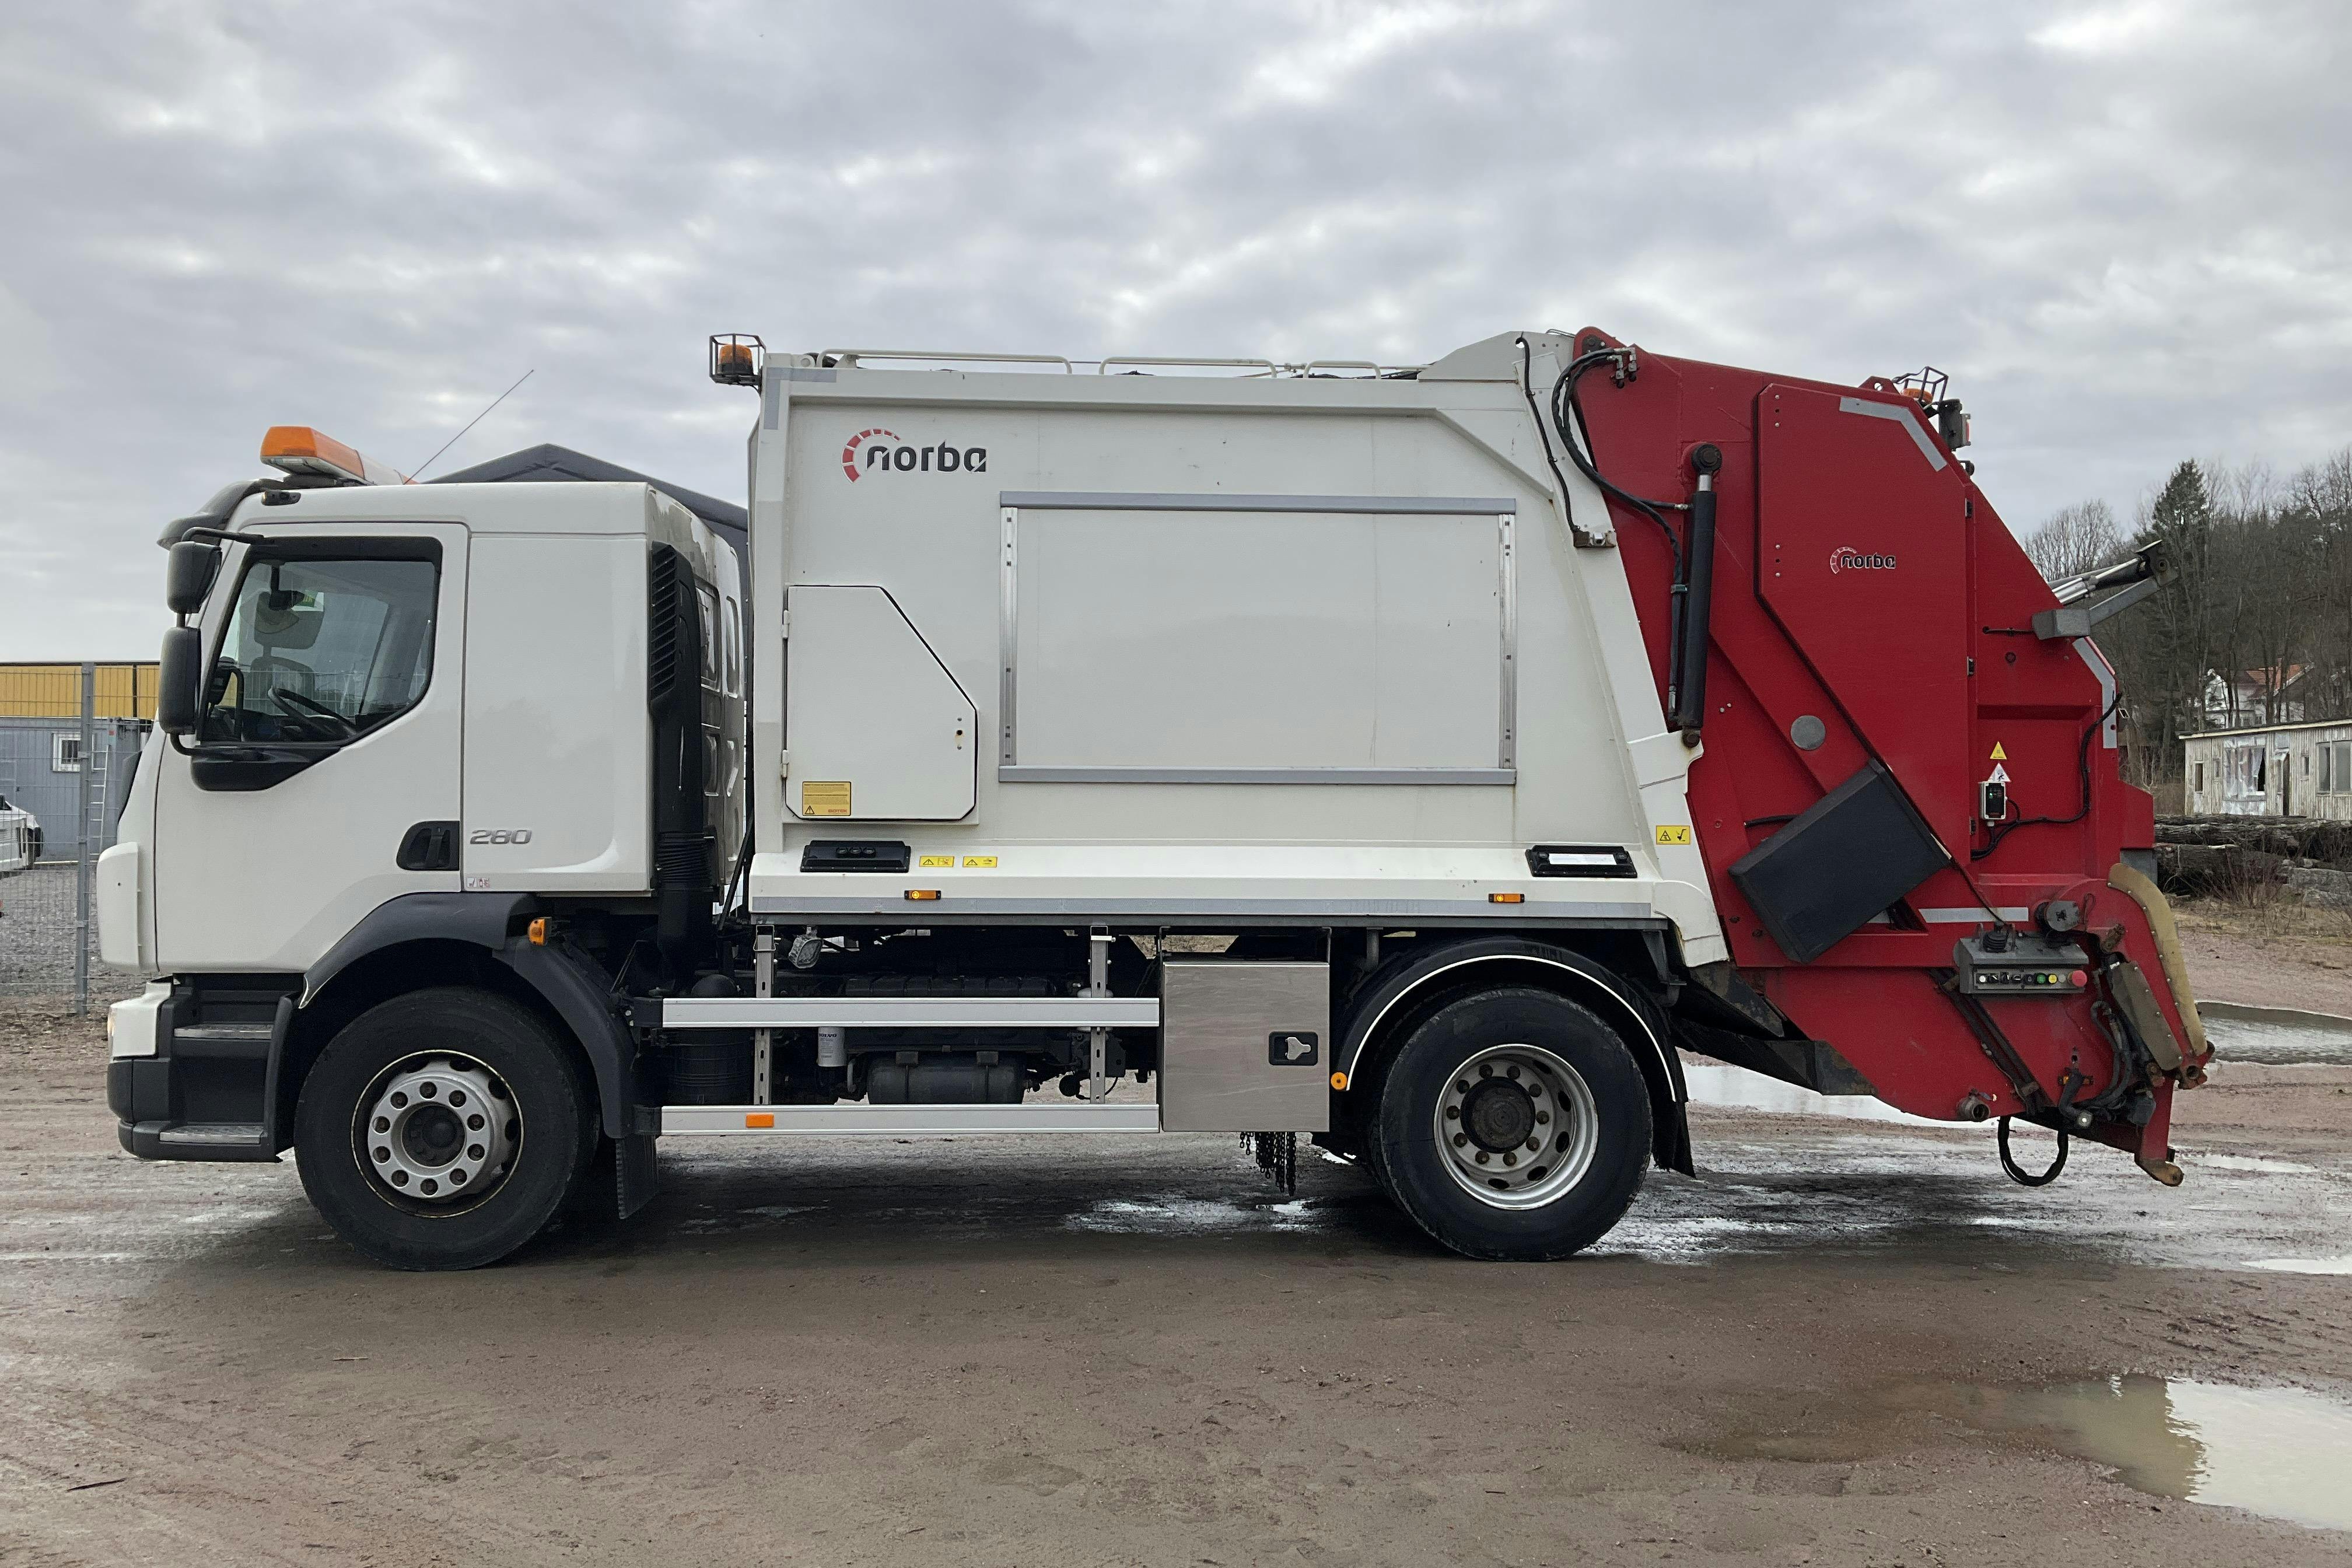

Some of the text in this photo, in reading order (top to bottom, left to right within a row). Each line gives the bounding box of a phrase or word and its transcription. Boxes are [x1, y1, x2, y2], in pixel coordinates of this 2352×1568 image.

[866, 439, 987, 472] norba
[1842, 552, 1896, 569] norba
[470, 830, 532, 845] 280
